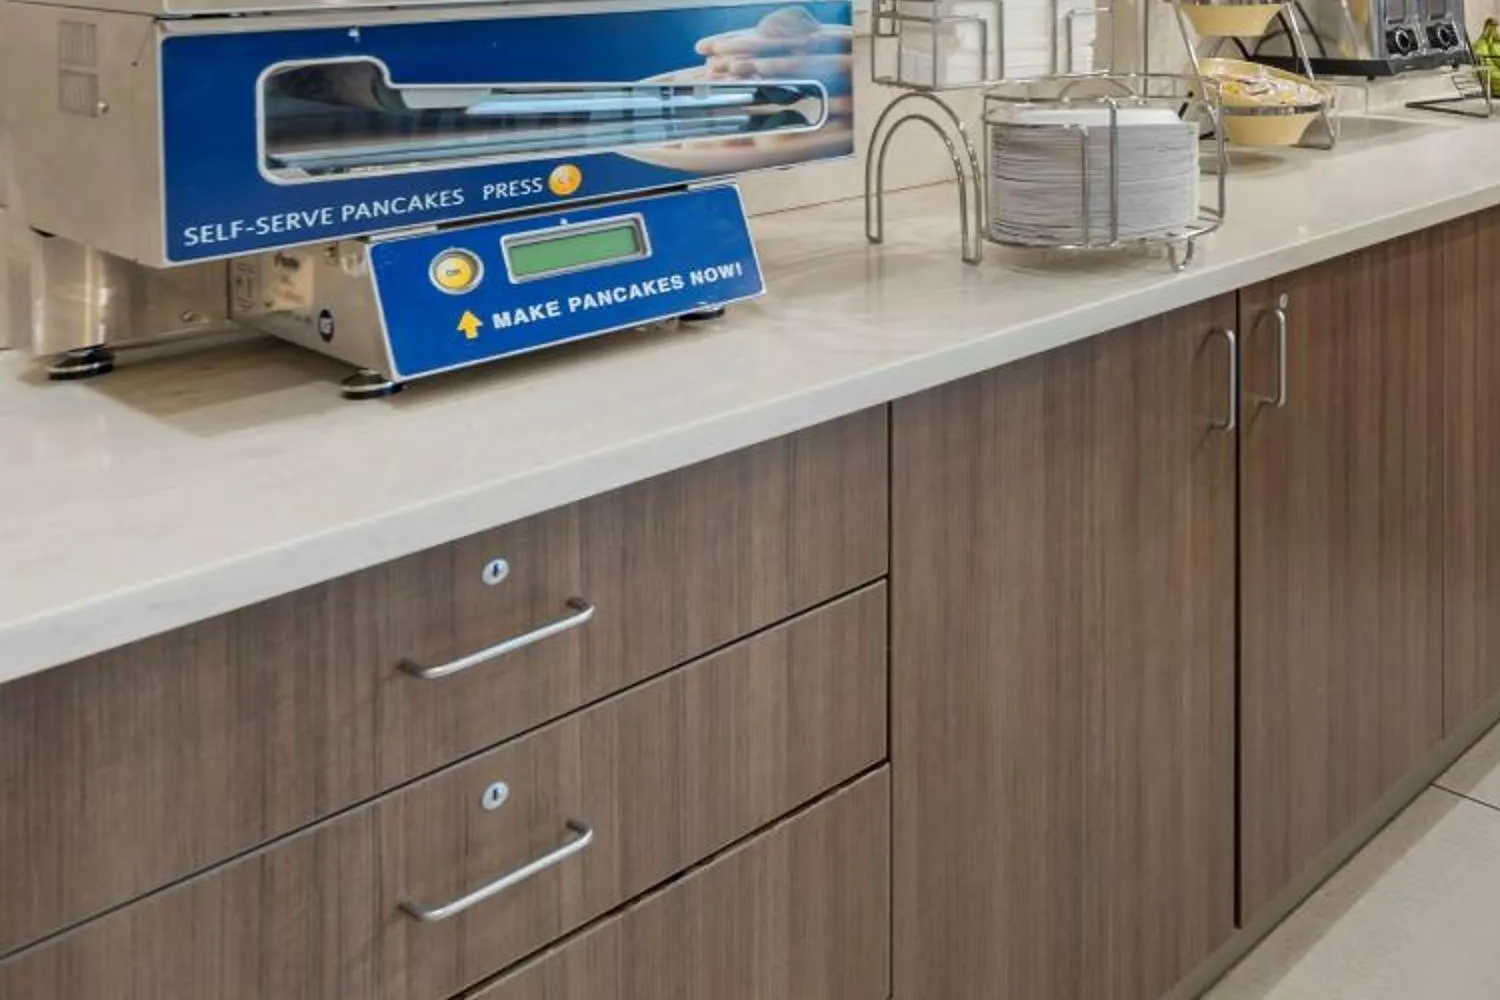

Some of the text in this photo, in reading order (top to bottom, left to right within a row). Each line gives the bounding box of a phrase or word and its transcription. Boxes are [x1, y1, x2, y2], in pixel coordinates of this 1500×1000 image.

[183, 176, 544, 247] SELF-SERVE PANCAKES PRESS
[491, 262, 743, 329] MAKE PANCAKES NOW!
